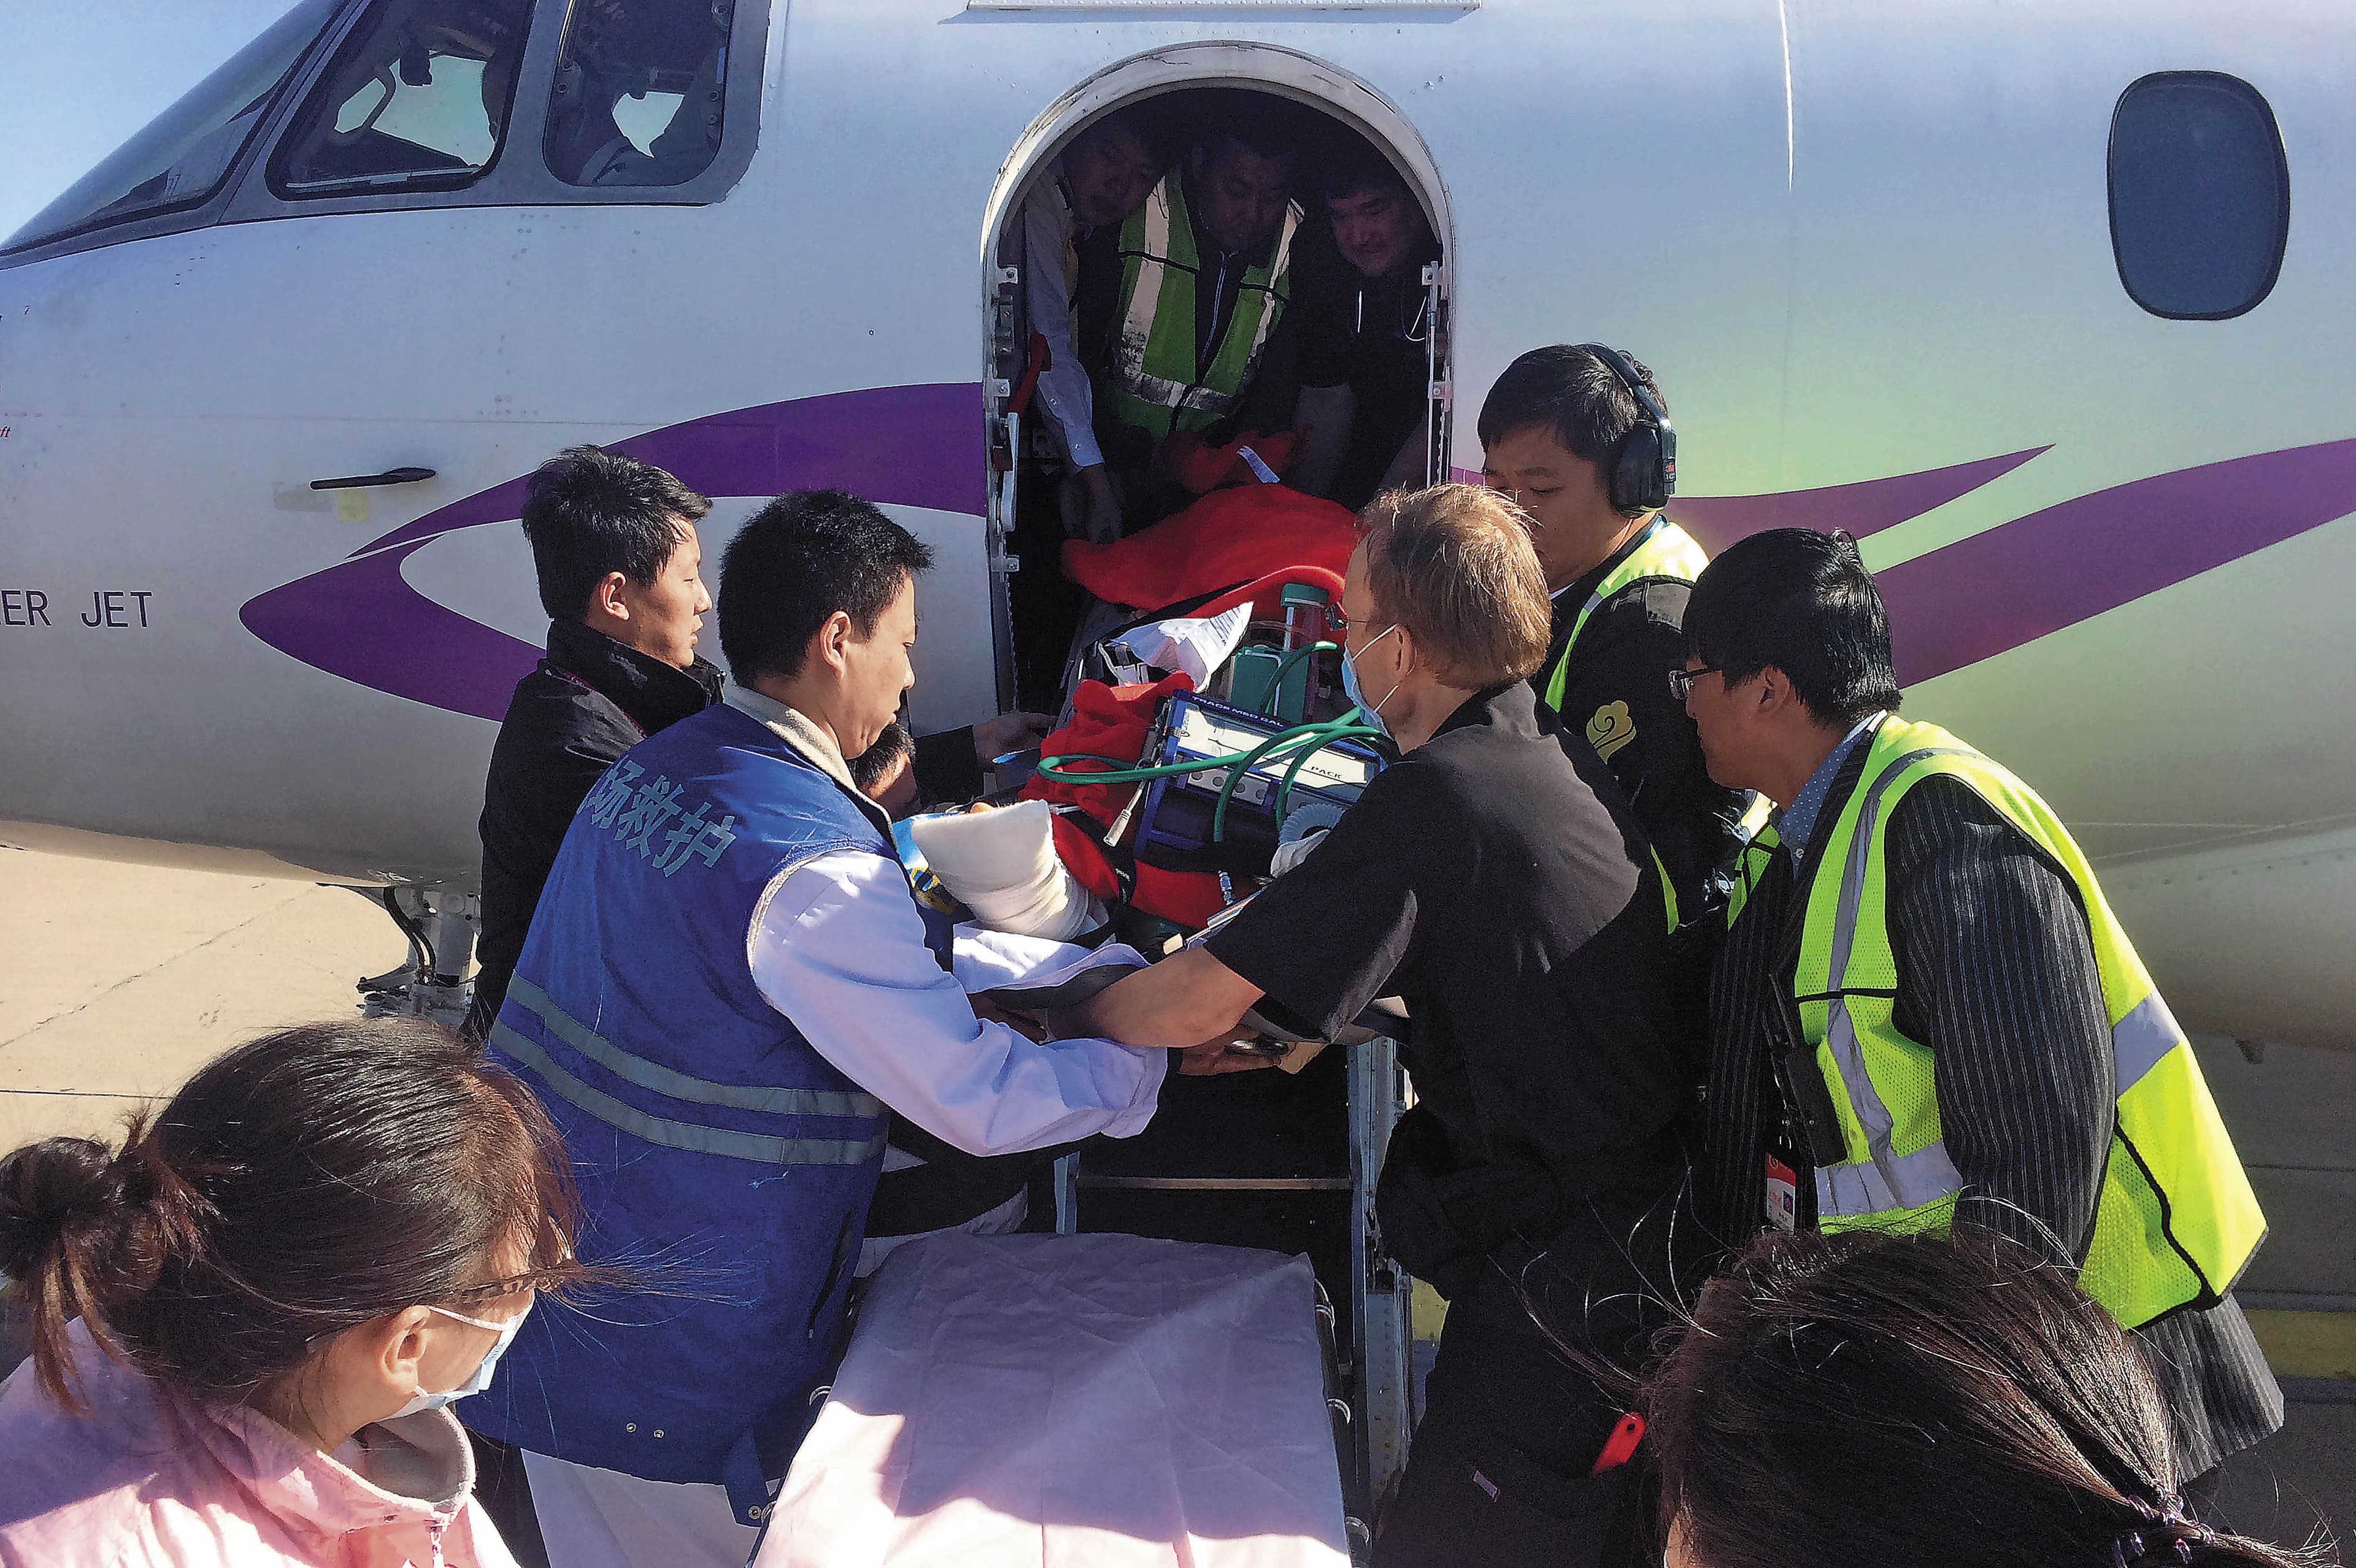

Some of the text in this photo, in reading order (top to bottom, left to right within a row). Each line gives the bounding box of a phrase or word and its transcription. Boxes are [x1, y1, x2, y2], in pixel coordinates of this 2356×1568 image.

[0, 590, 153, 628] ER JET
[1311, 766, 1342, 779] PACK
